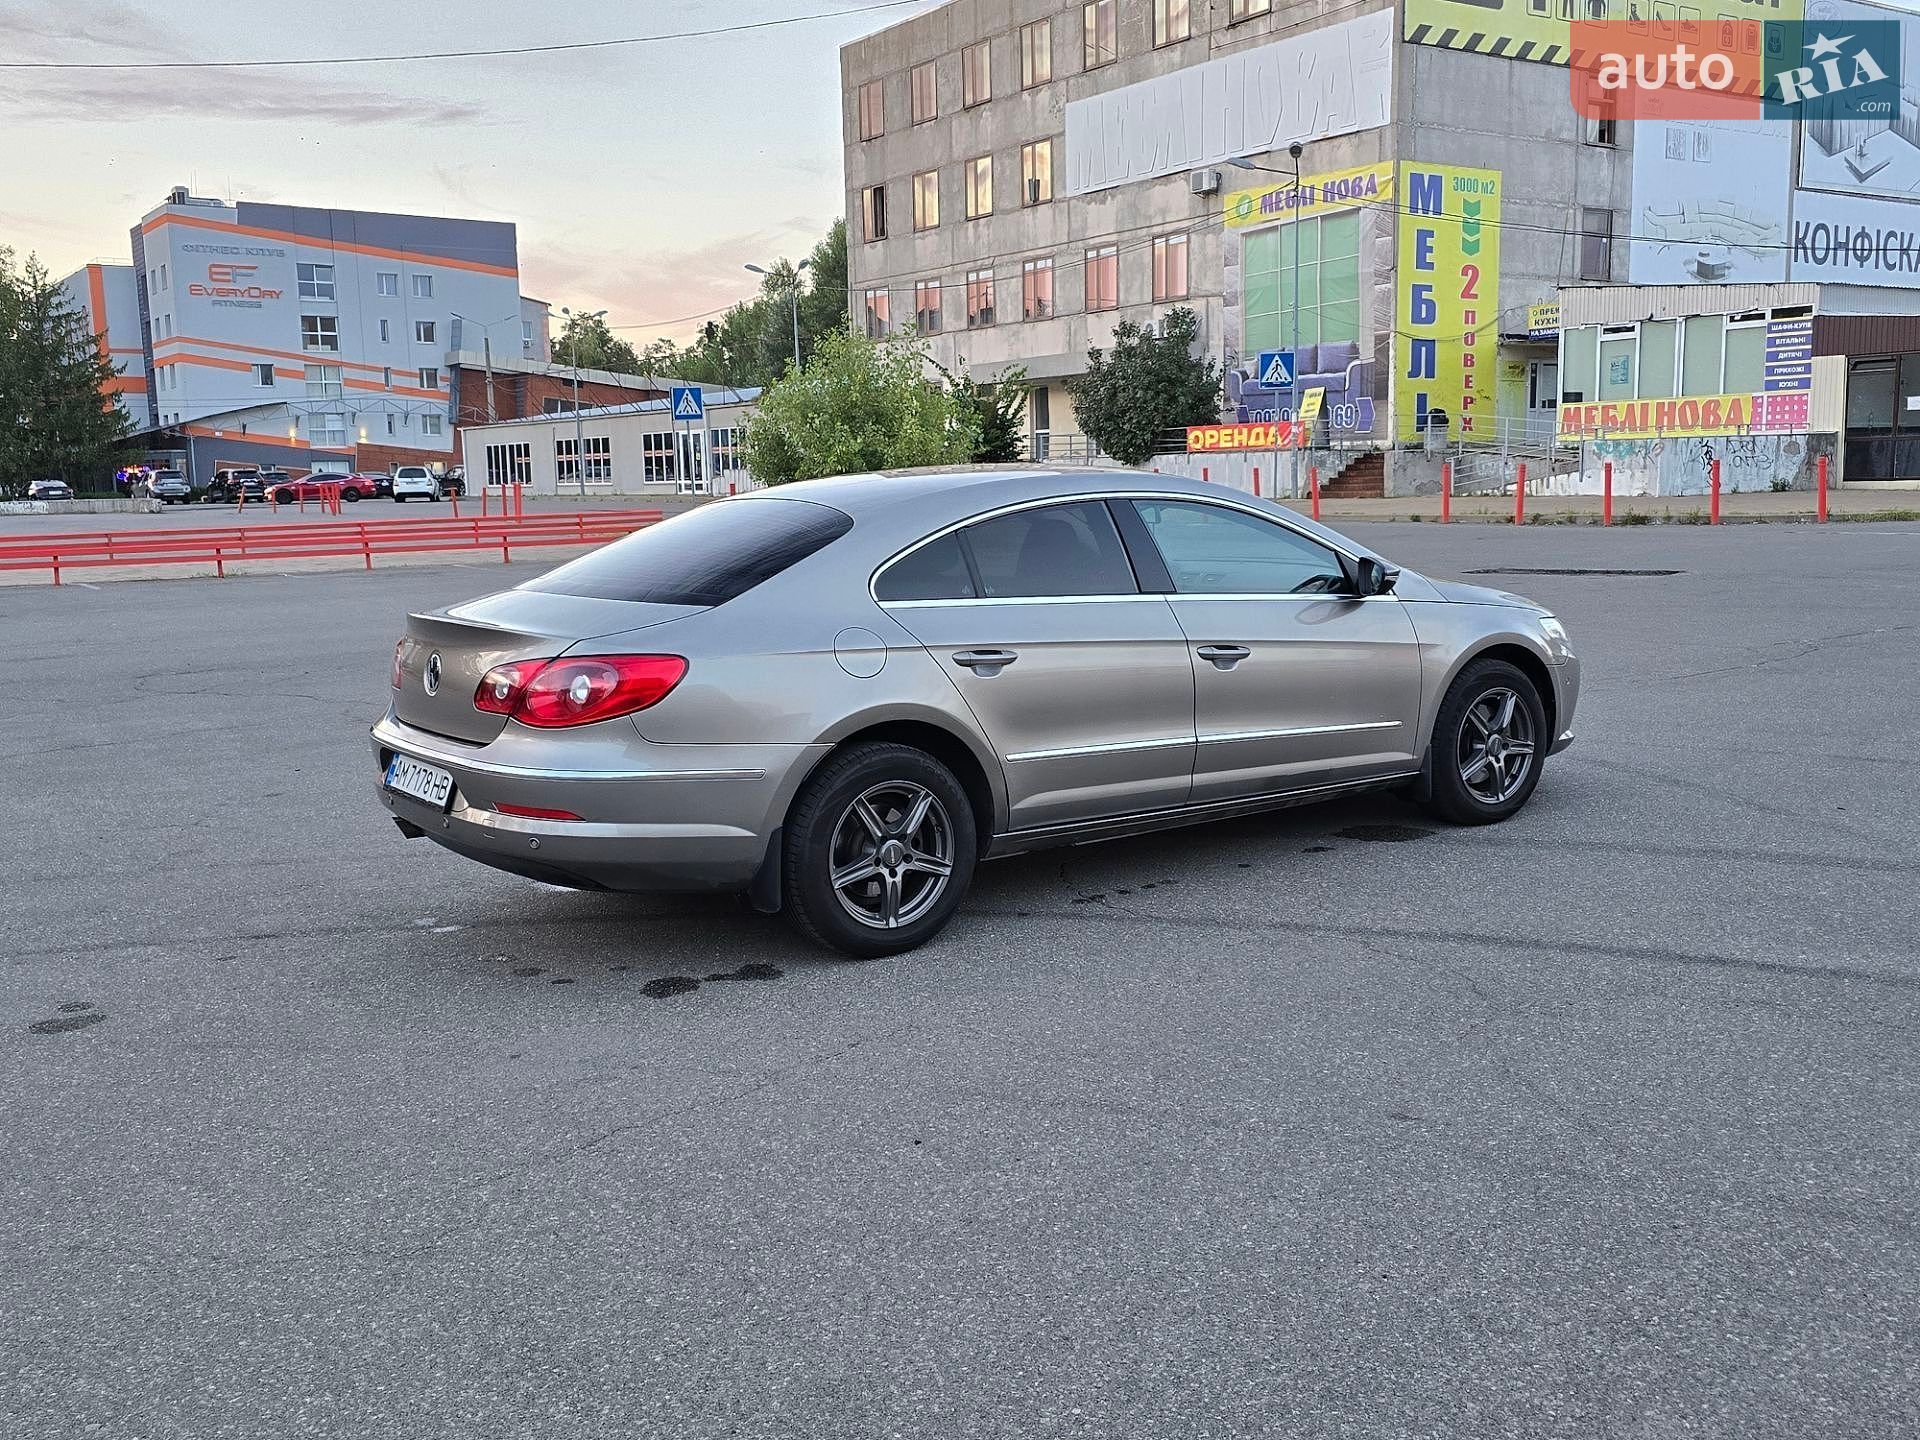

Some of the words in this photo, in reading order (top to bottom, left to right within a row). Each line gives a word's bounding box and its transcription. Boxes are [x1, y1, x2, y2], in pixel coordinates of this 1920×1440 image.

[1322, 173, 1378, 203] НОВА
[1453, 176, 1479, 193] 3000
[1461, 264, 1480, 299] 2
[1560, 402, 1650, 434] МЕБЛІ
[1655, 397, 1744, 432] НОВА
[1188, 426, 1281, 450] ОРЕНДА
